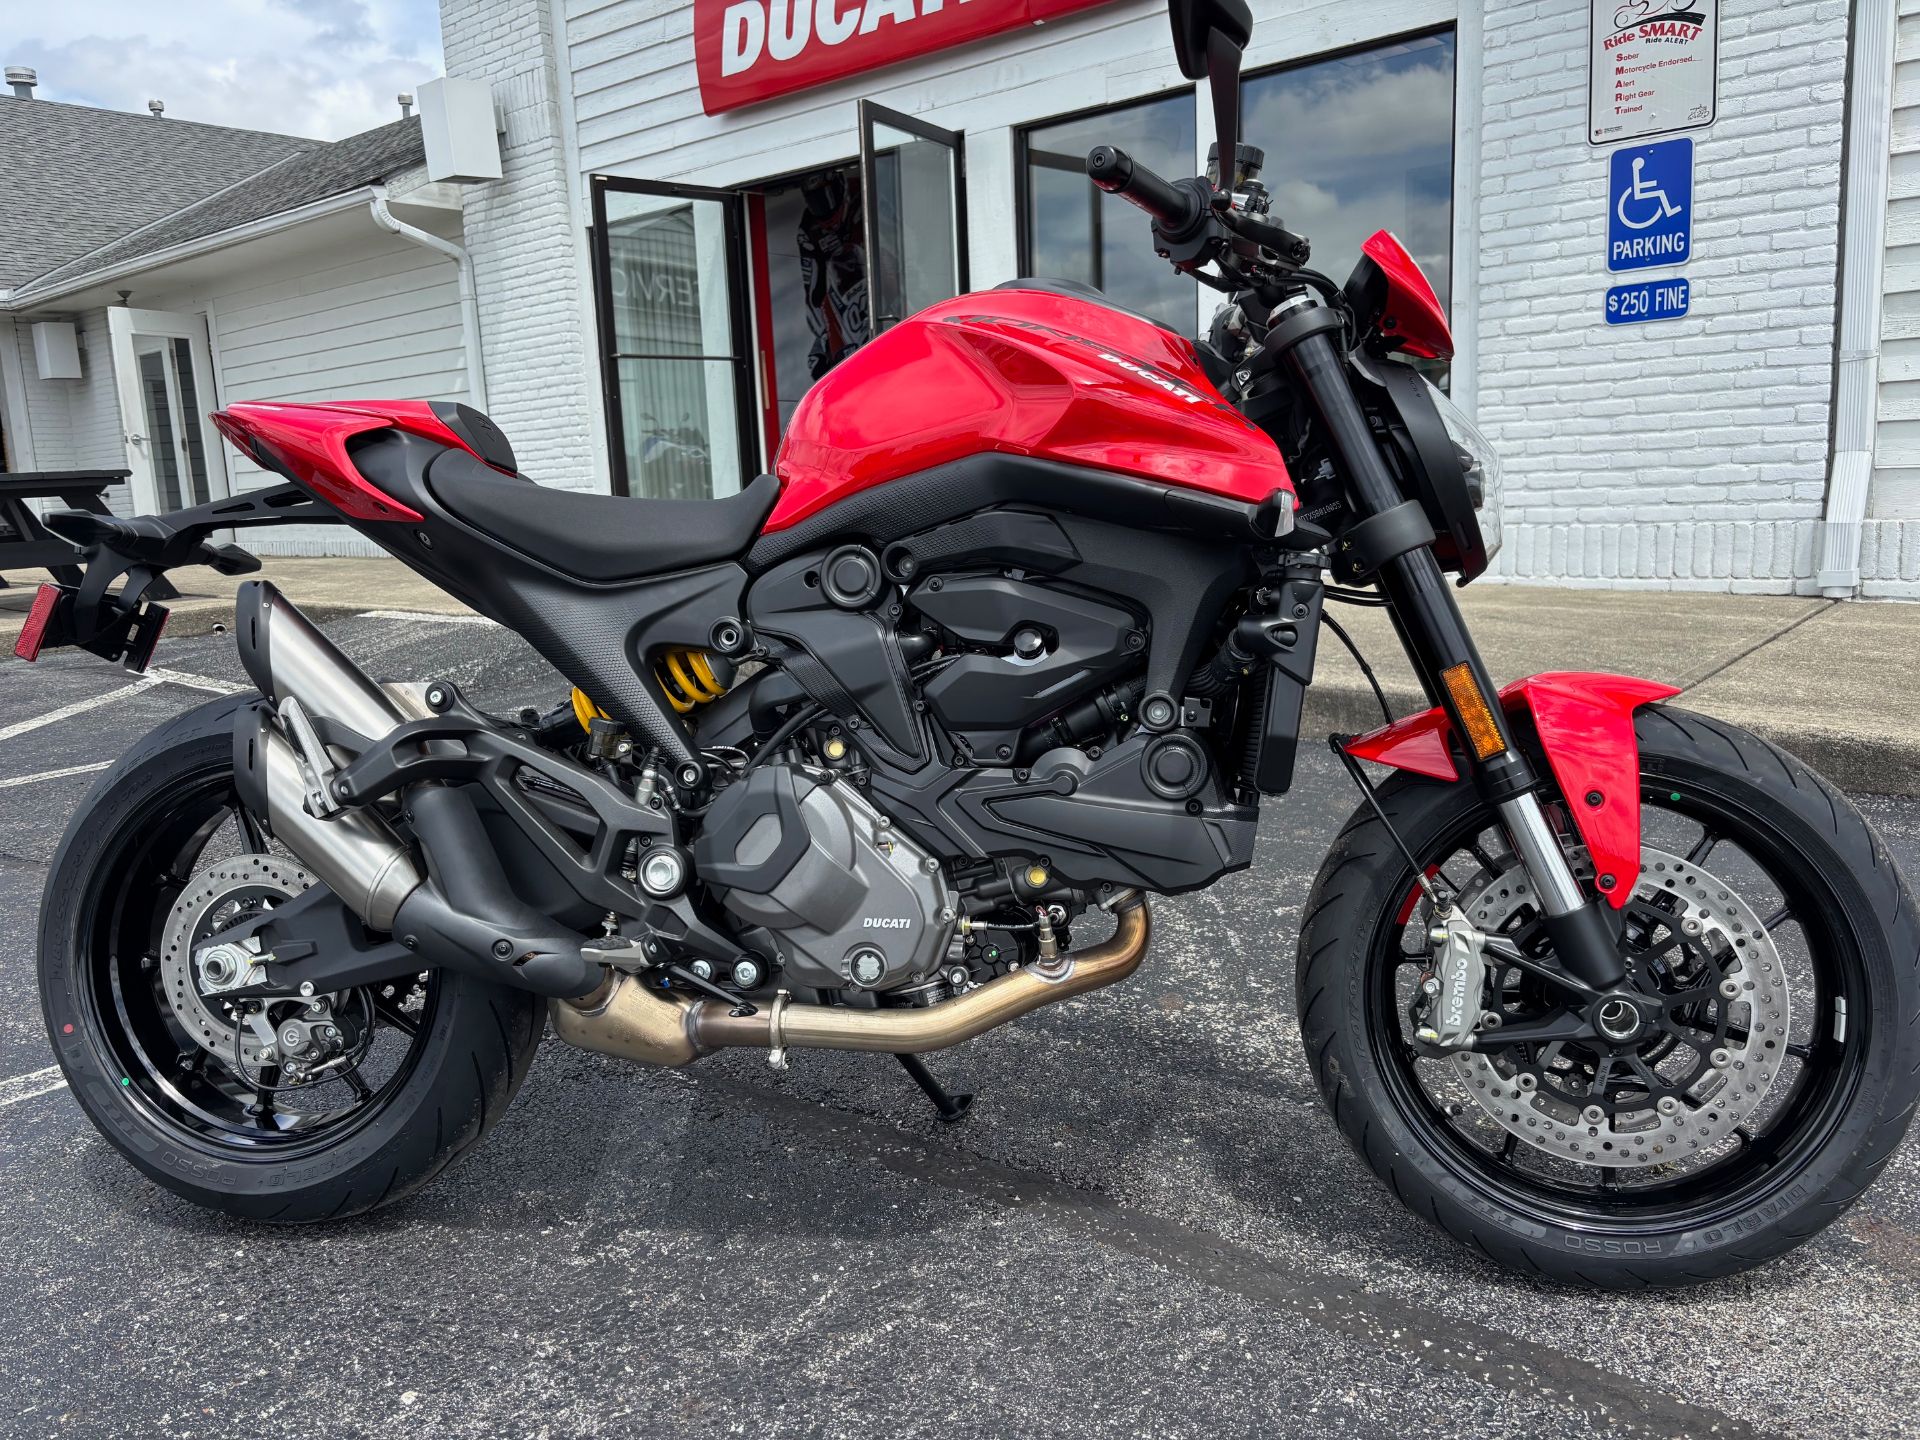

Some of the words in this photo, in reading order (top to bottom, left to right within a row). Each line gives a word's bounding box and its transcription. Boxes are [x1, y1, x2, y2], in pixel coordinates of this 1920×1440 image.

[721, 0, 972, 77] DUCA
[1603, 30, 1636, 51] Ride
[1638, 22, 1704, 41] SMART
[1645, 37, 1663, 45] Ride
[1665, 37, 1689, 45] ALERT
[1615, 52, 1640, 62] Sober
[1615, 62, 1657, 76] Motorcycle
[1658, 54, 1693, 68] Endorsed
[1615, 79, 1635, 89] Alert
[1615, 92, 1637, 102] Right
[1637, 90, 1655, 99] Gear
[1614, 104, 1643, 115] Trained
[1613, 232, 1685, 260] PARKING
[1608, 289, 1649, 316] $250
[1655, 285, 1687, 312] FINE
[1098, 353, 1203, 404] DUCATI
[863, 916, 911, 931] DUCATI
[1445, 957, 1468, 1027] brembo
[1703, 1184, 1807, 1246] DIABLO
[1563, 1234, 1662, 1254] ROSSO
